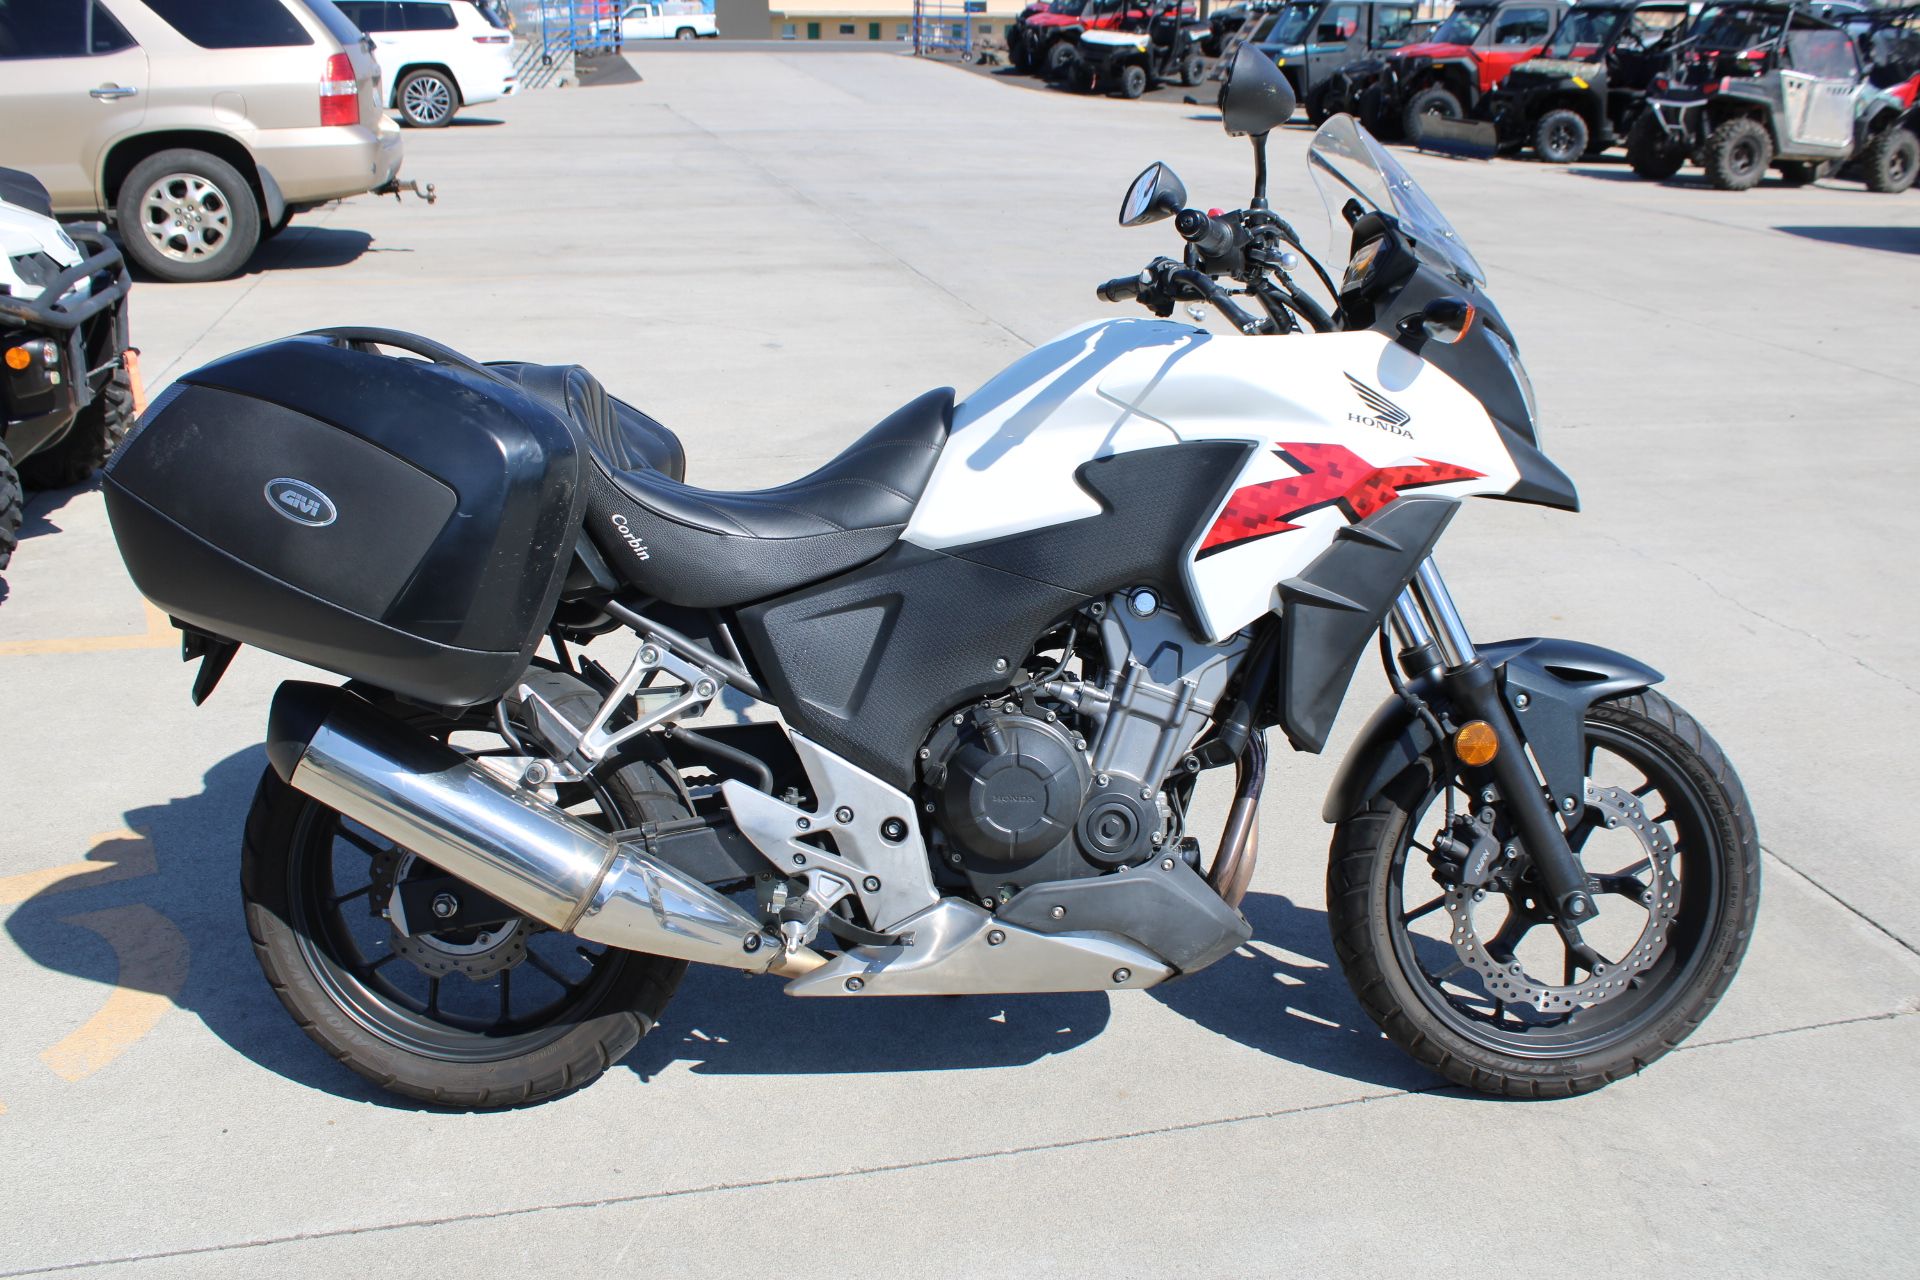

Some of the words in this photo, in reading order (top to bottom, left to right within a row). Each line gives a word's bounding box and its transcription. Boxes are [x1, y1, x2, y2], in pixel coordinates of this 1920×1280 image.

[1348, 413, 1414, 440] HONDA
[280, 490, 321, 517] GIVI
[612, 514, 649, 560] Corbin
[310, 1000, 370, 1046] AVON
